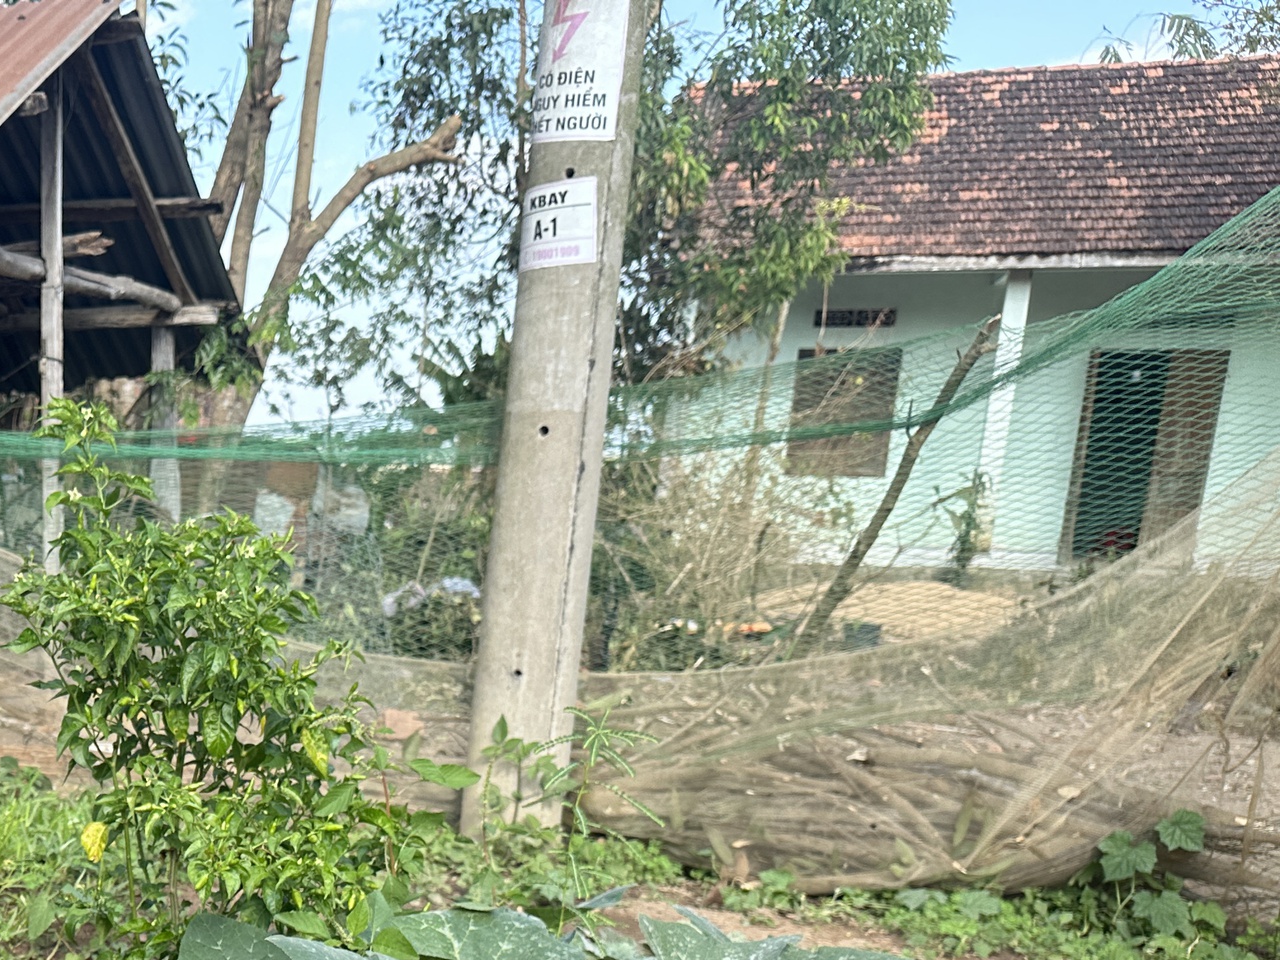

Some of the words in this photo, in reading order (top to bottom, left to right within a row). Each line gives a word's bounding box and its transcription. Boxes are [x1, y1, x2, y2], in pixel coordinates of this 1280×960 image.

[539, 71, 554, 89] CÓ
[558, 67, 596, 88] ĐIỆN
[533, 95, 561, 112] GUY
[565, 86, 607, 108] HIỂM
[555, 112, 608, 131] NGƯỜI
[530, 190, 568, 211] KBAY
[534, 216, 558, 242] A-1
